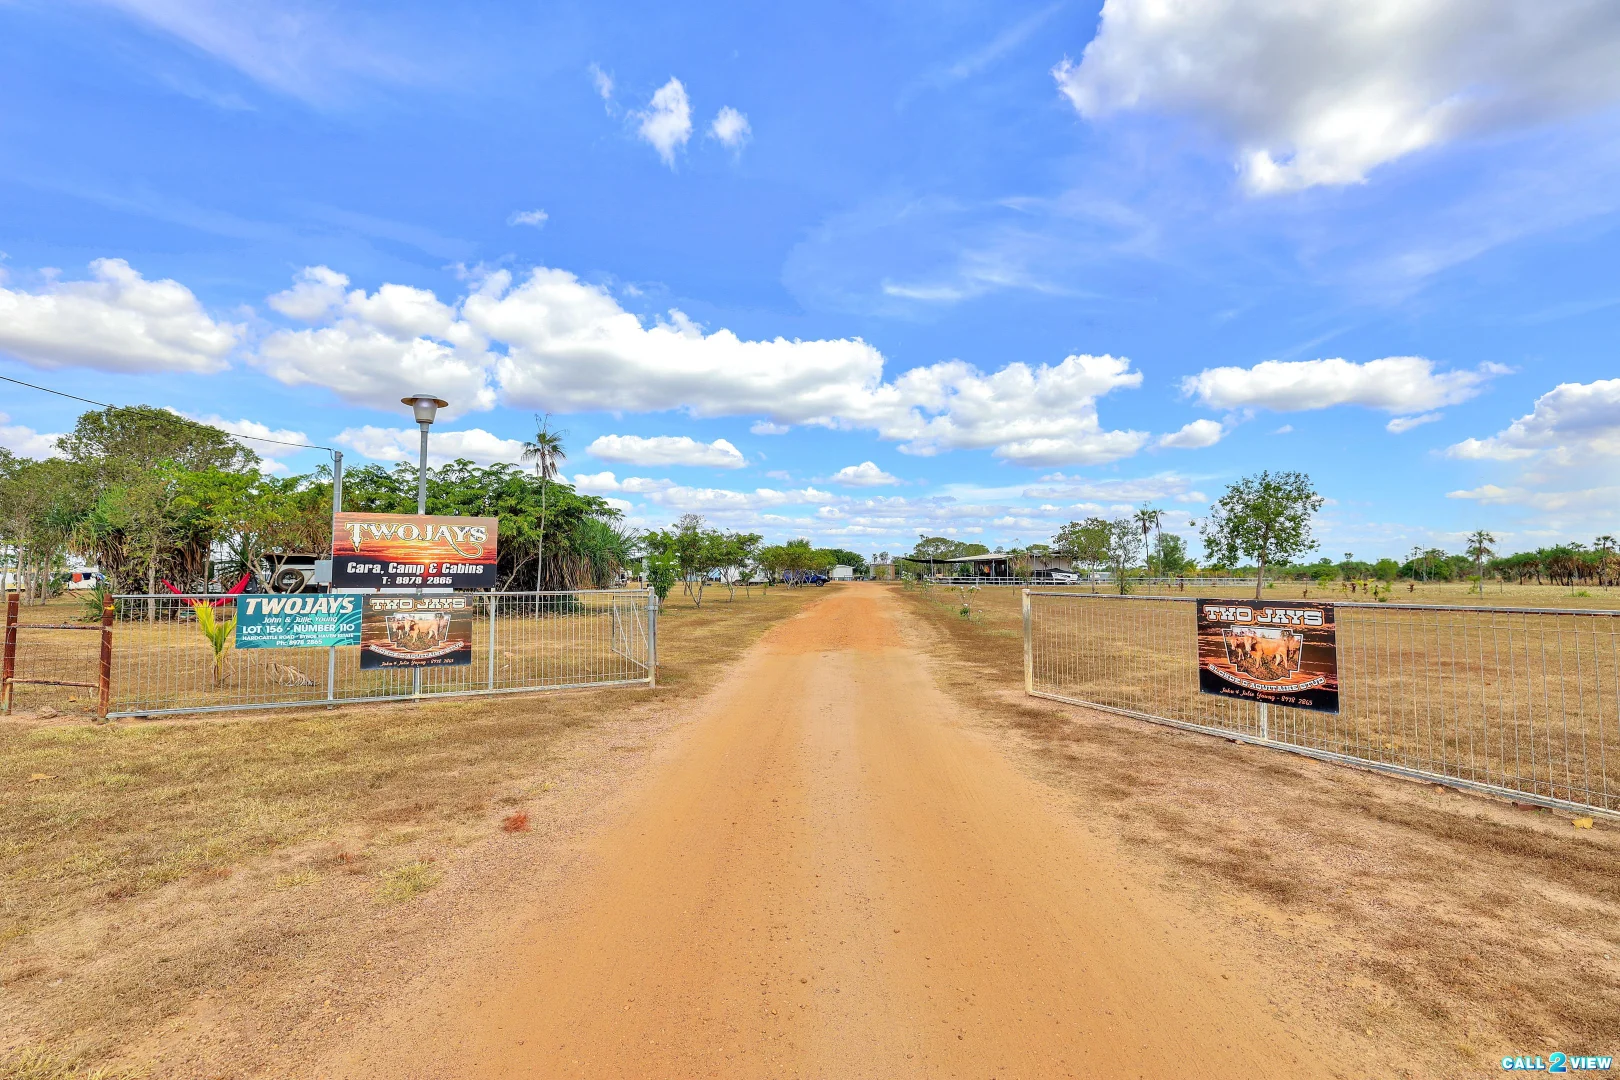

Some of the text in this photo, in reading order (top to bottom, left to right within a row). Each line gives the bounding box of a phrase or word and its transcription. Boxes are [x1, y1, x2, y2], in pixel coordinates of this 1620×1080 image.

[347, 562, 484, 576] Cara, Camp & Cabins
[382, 576, 391, 585] T:
[426, 576, 453, 585] 2865
[245, 597, 355, 615] TWOJAYS
[370, 597, 466, 611] TWO JAYS
[261, 616, 282, 624] John
[1203, 605, 1324, 626] TWO JAYS
[242, 625, 263, 634] LOT
[265, 625, 283, 633] 156
[293, 624, 336, 633] NUMBER
[339, 623, 355, 631] 110
